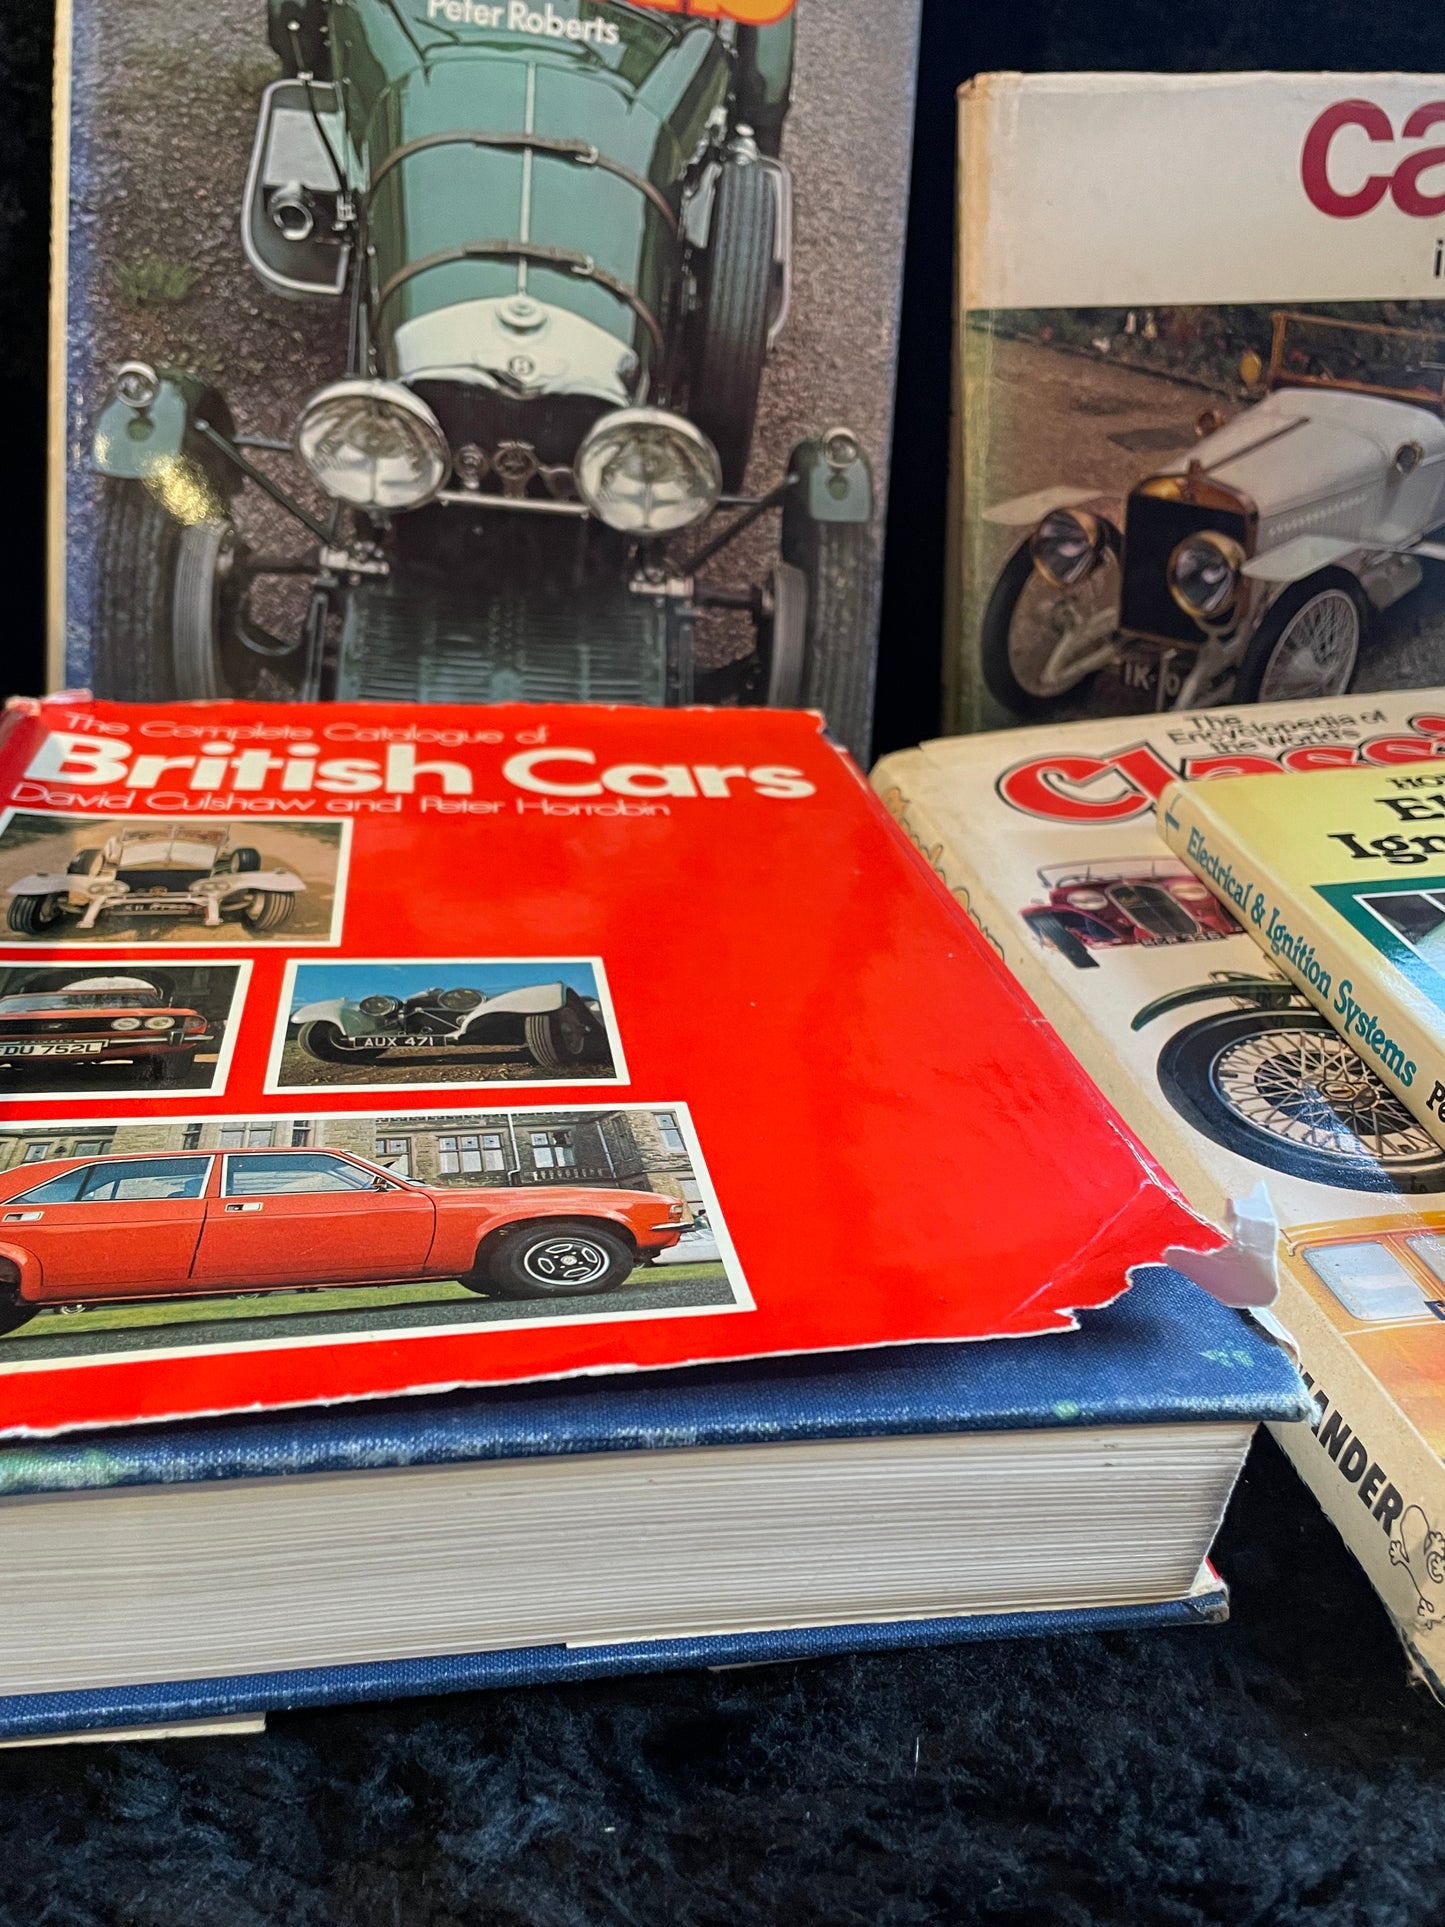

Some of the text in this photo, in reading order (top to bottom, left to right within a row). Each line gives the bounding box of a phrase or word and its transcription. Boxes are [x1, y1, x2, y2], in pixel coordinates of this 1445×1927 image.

[426, 0, 502, 28] Peter
[507, 0, 620, 45] Roberts
[63, 711, 549, 747] The Complete Catalogue of
[1166, 709, 1389, 746] Encyclopedia of
[1185, 712, 1242, 731] The
[24, 730, 817, 799] British Cars
[1208, 739, 1257, 755] the
[11, 781, 671, 816] David Culshaw and Peter Horrobin
[1388, 774, 1445, 790] HO
[1186, 826, 1253, 913] Electrical
[1250, 892, 1266, 929] &
[1265, 907, 1333, 1000] Ignition
[1333, 979, 1418, 1088] Systems
[39, 1043, 99, 1055] 752L
[364, 1036, 434, 1047] AUX 471
[1300, 1363, 1404, 1538] ANDER
